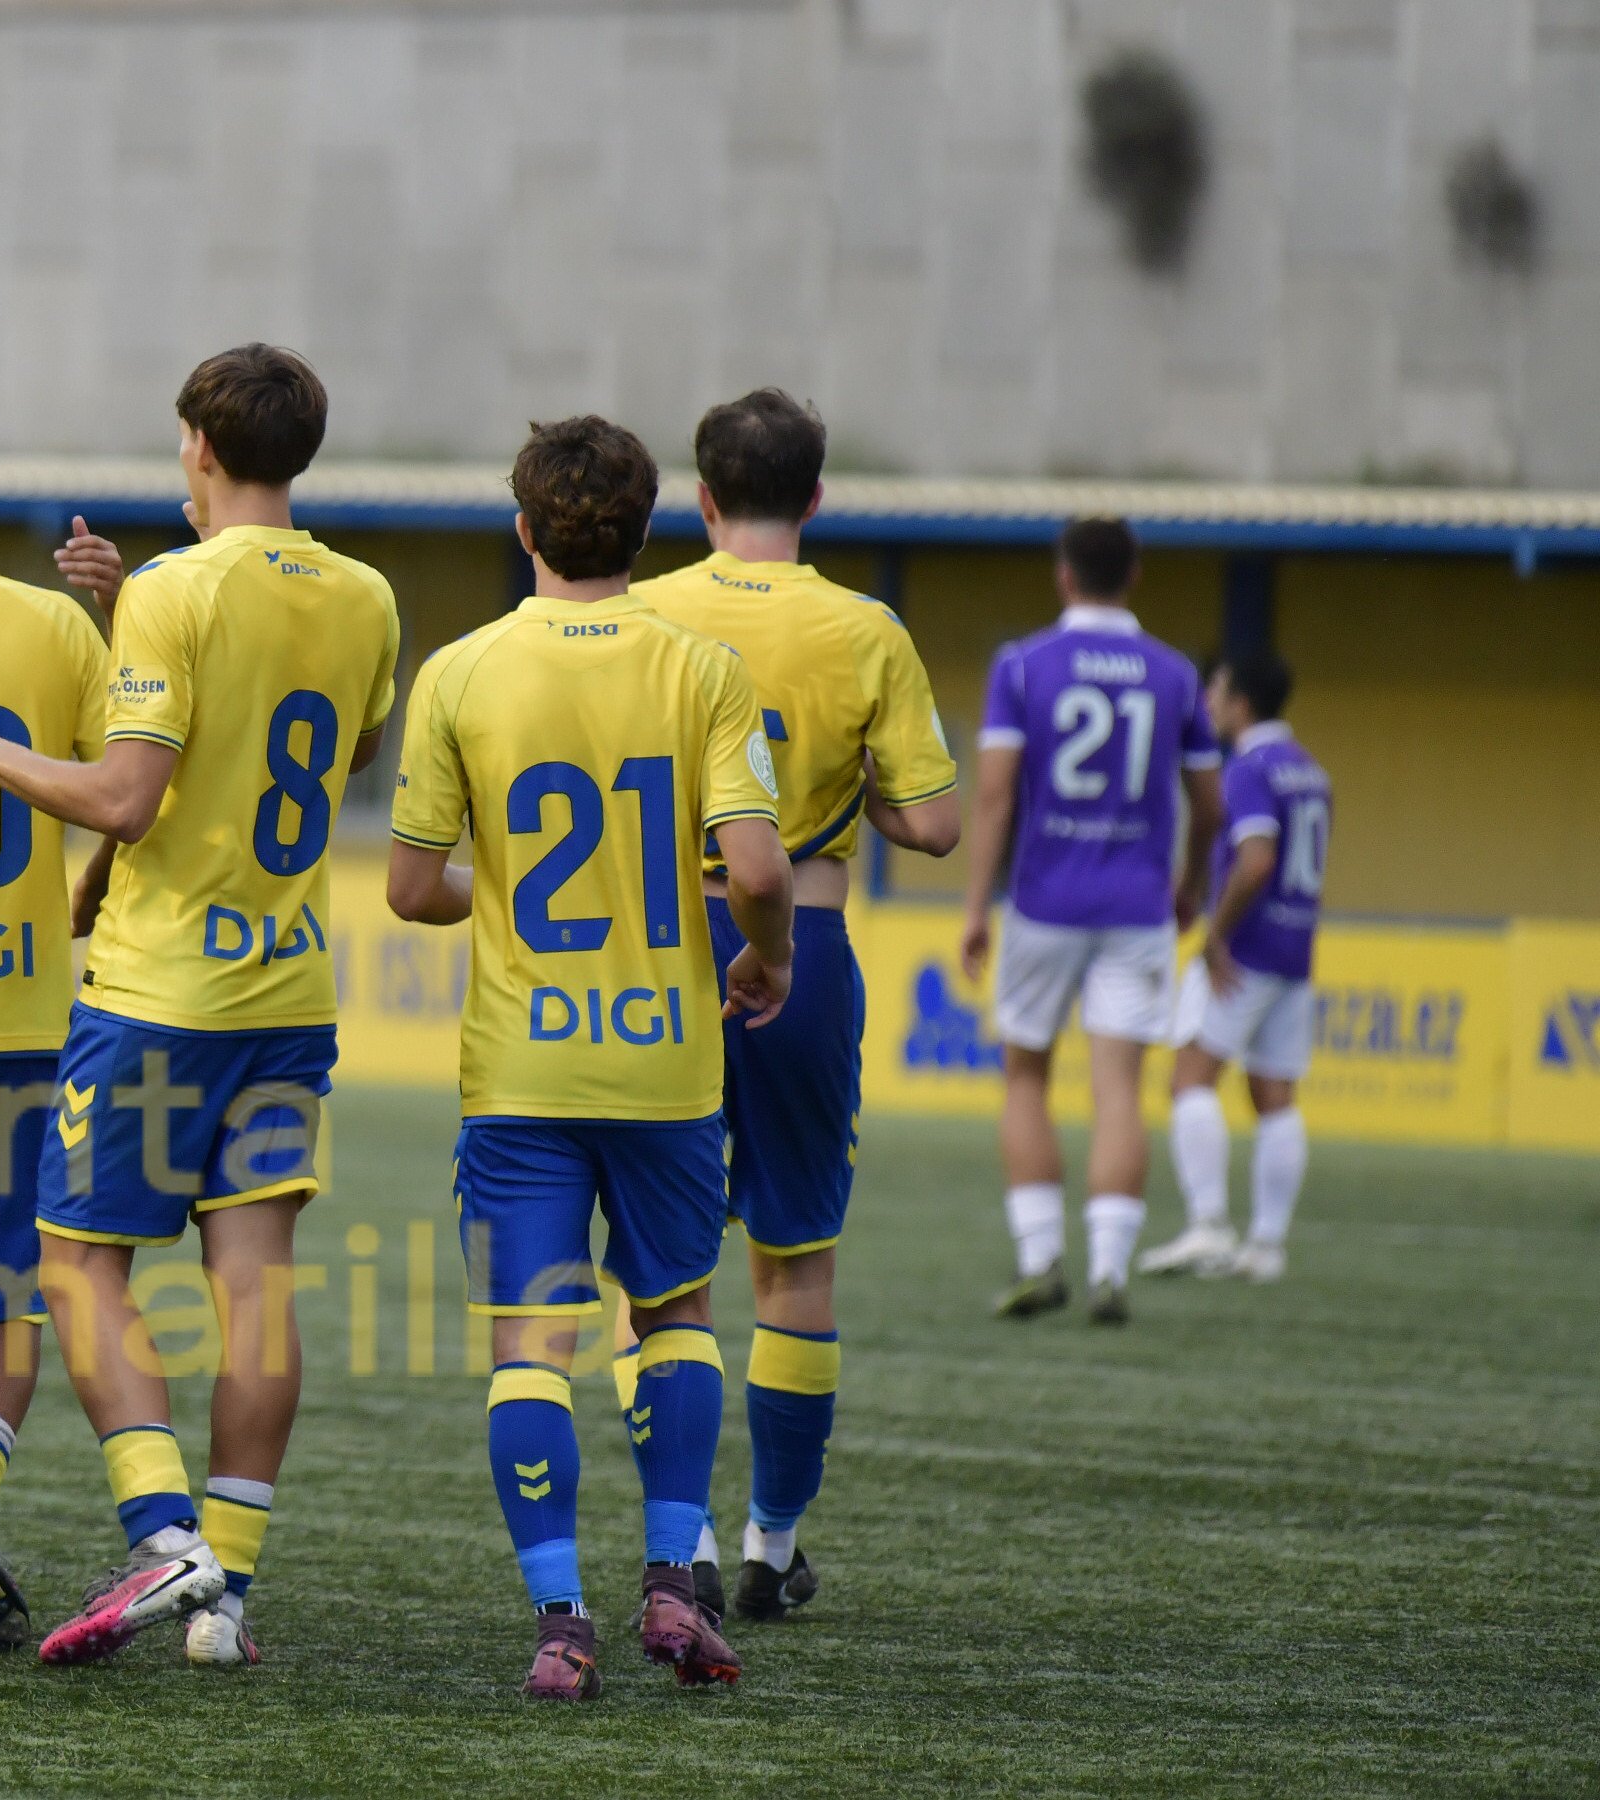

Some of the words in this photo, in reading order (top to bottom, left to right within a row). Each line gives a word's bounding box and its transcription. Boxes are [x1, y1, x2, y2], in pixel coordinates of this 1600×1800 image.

[123, 680, 165, 693] OLSEN
[1054, 684, 1157, 803] 21
[253, 689, 339, 877] 8
[507, 755, 681, 954] 21
[529, 986, 684, 1046] DIGI
